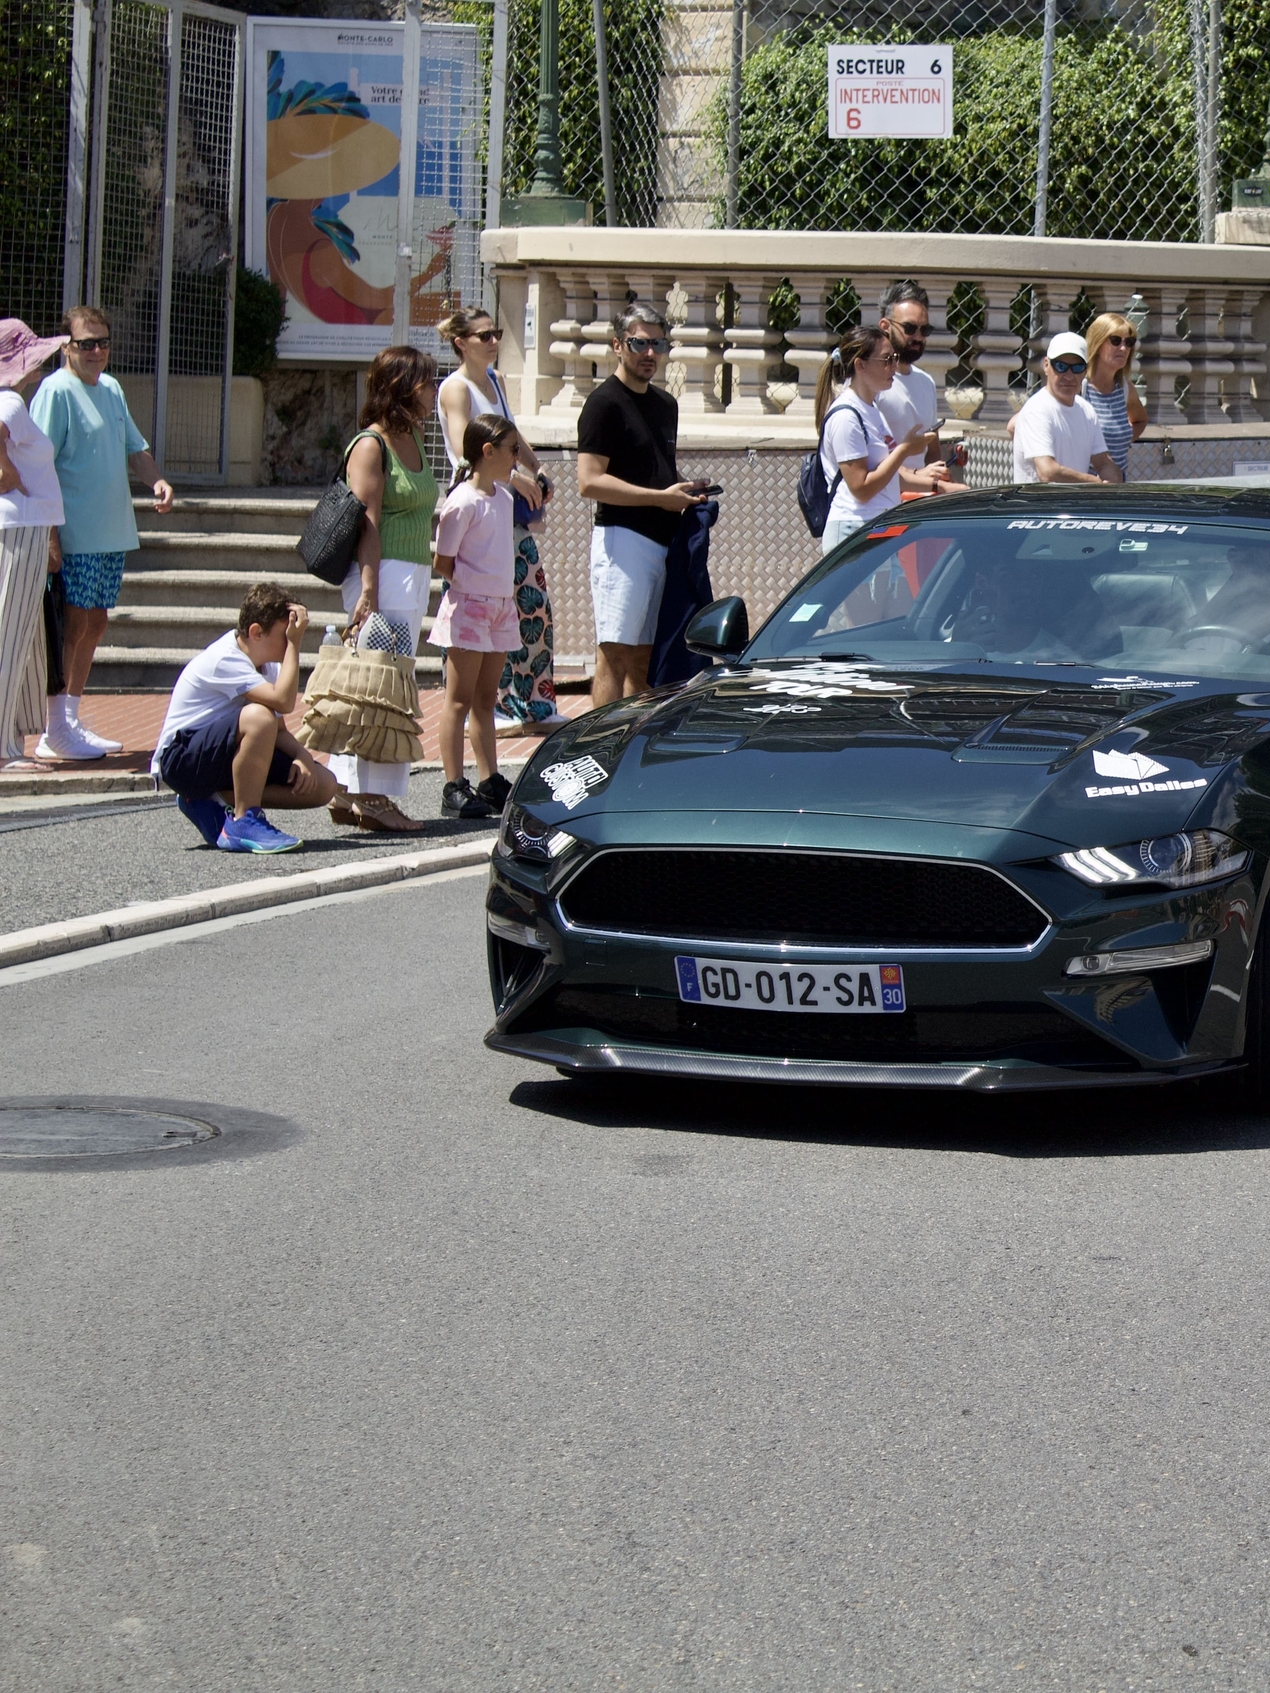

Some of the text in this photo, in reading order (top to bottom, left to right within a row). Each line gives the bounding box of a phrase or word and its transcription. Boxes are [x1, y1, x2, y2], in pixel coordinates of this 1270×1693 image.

[337, 33, 394, 43] MONTE-CARLO
[836, 58, 942, 75] SECTEUR 6
[371, 86, 398, 95] Votre
[839, 88, 941, 104] INTERVENTION
[846, 107, 862, 130] 6
[1006, 520, 1189, 535] AUTOREVE34
[1085, 778, 1208, 798] Easy Dalles
[686, 982, 693, 992] F
[701, 965, 877, 1007] GD-012-SA
[883, 988, 902, 1005] 30
